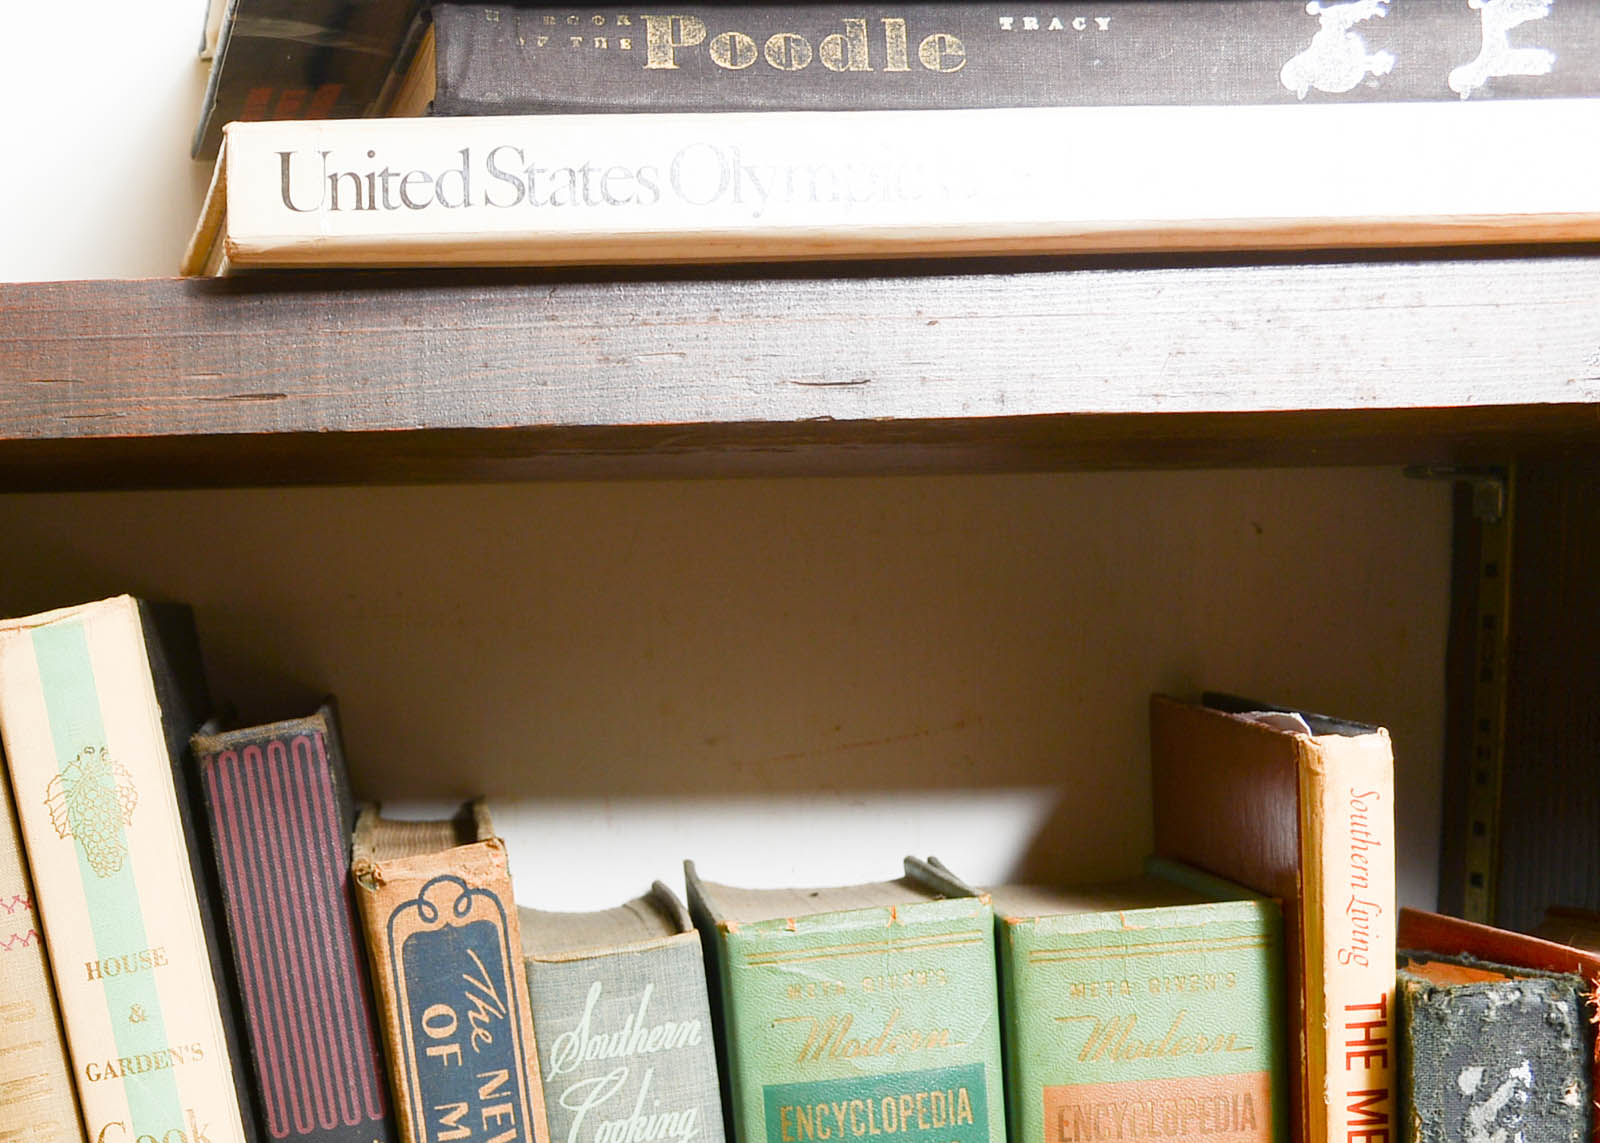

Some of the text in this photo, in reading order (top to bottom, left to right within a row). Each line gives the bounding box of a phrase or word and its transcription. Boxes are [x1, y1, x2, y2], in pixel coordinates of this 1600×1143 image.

[640, 14, 967, 74] Poodle
[999, 15, 1112, 32] TRACY
[277, 145, 660, 212] United States
[1337, 787, 1382, 969] Southern Living
[85, 946, 169, 982] HOUSE
[1070, 979, 1131, 1000] META
[129, 1003, 148, 1025] &
[462, 948, 506, 1054] The
[421, 1003, 464, 1067] OF
[545, 980, 701, 1082] Southern
[1054, 1008, 1254, 1063] Modern
[1344, 992, 1388, 1071] THE
[86, 1042, 205, 1082] GARDEN'S
[779, 1087, 974, 1143] ENCYCLOPEDIA
[1058, 1092, 1257, 1143] ENCYCLOPEDIA
